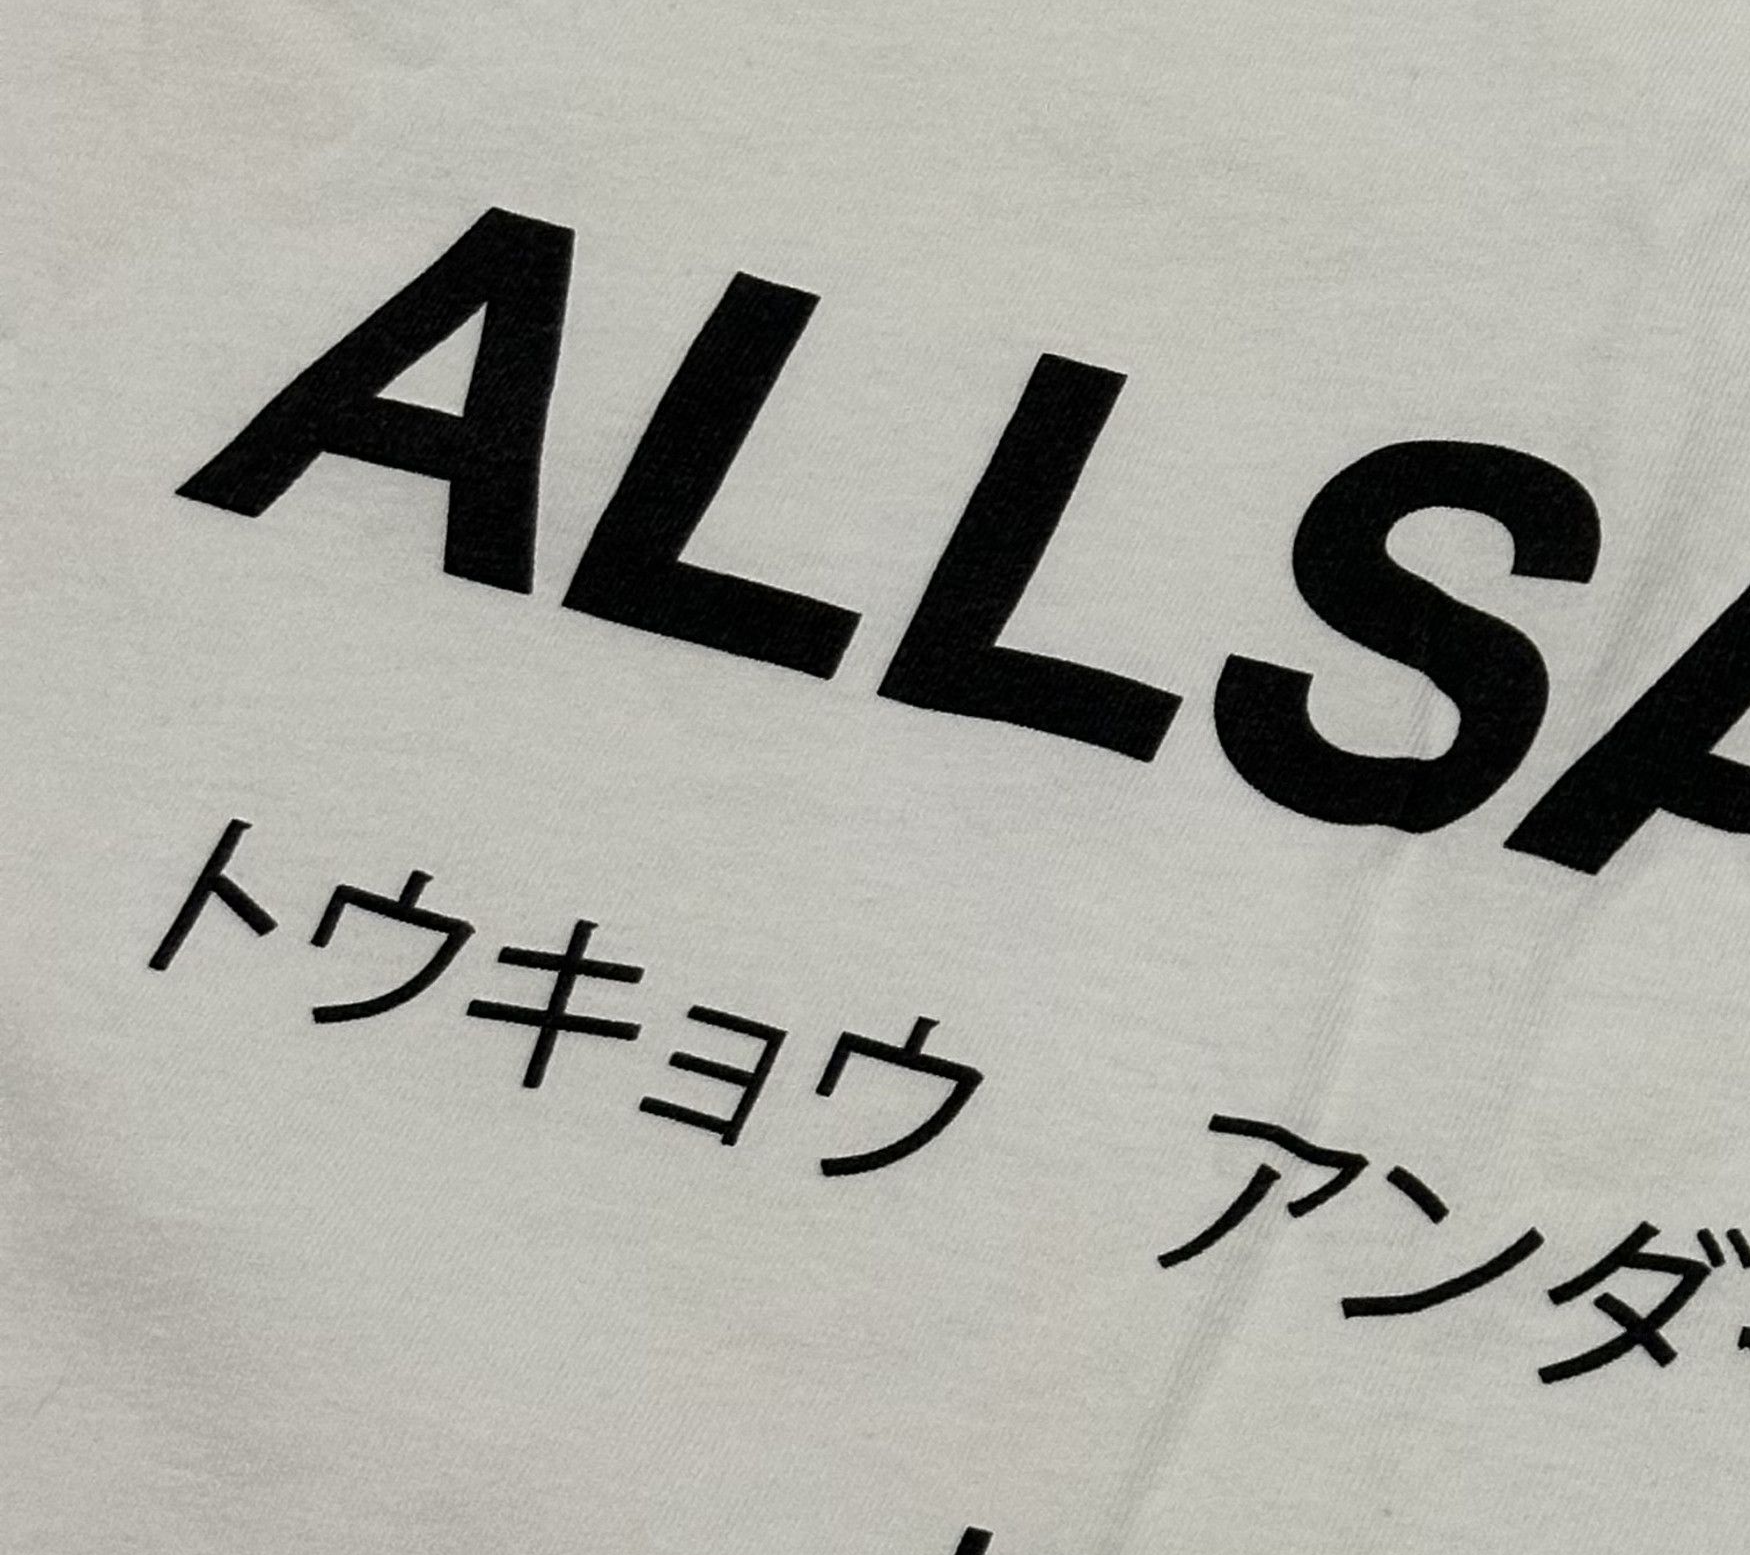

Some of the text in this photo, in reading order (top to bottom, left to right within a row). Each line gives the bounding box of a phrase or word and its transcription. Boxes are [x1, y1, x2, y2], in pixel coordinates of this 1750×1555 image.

[148, 818, 984, 1179] トウキョウ
